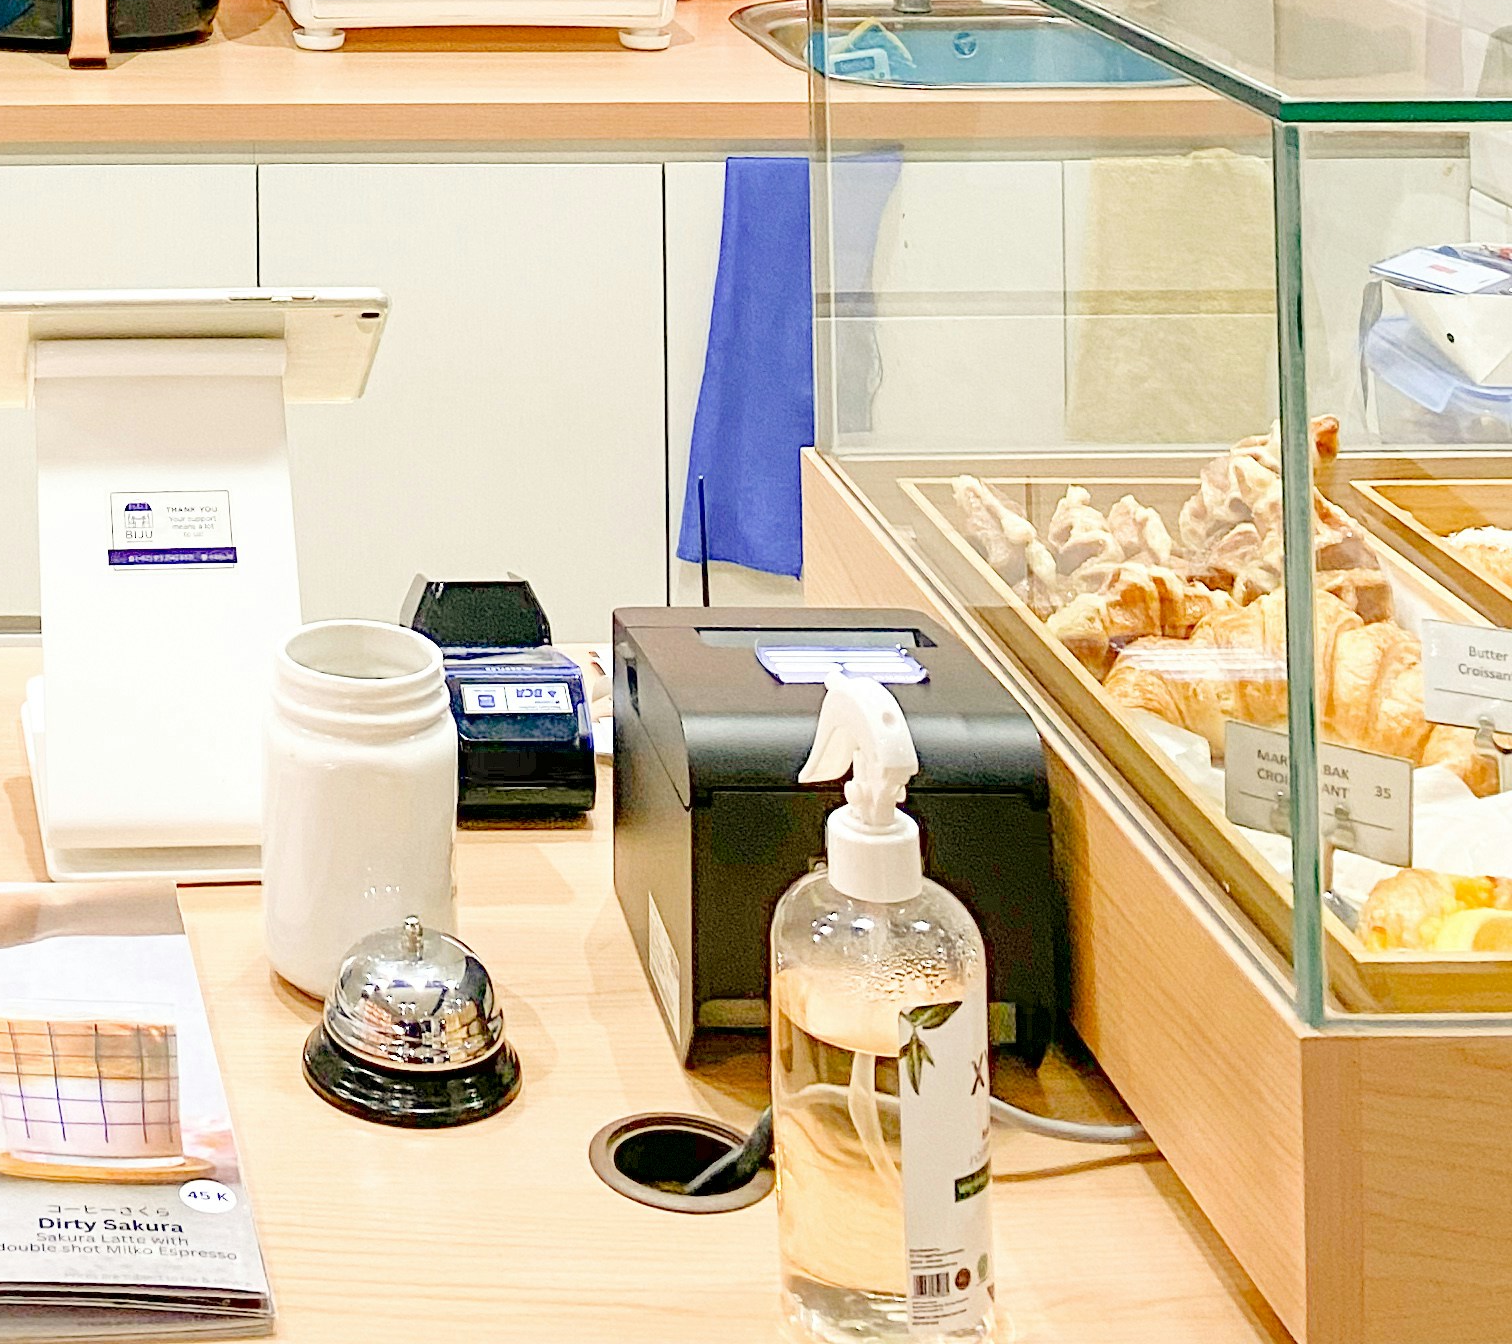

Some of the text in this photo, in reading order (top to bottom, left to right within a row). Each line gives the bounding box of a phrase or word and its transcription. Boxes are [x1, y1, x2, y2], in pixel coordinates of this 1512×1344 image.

[125, 530, 153, 539] BIJU
[1468, 645, 1509, 662] Butter
[1458, 663, 1512, 681] Croissan
[1256, 748, 1350, 780] MARBAK
[1256, 767, 1350, 799] CROIANT
[1374, 785, 1392, 800] 35
[187, 1190, 228, 1202] 45 K
[38, 1217, 184, 1234] Dirty Sakura
[36, 1231, 189, 1247] Sakura Latte with
[62, 1243, 100, 1255] shot
[106, 1244, 153, 1256] Milko
[159, 1246, 238, 1261] Espresso
